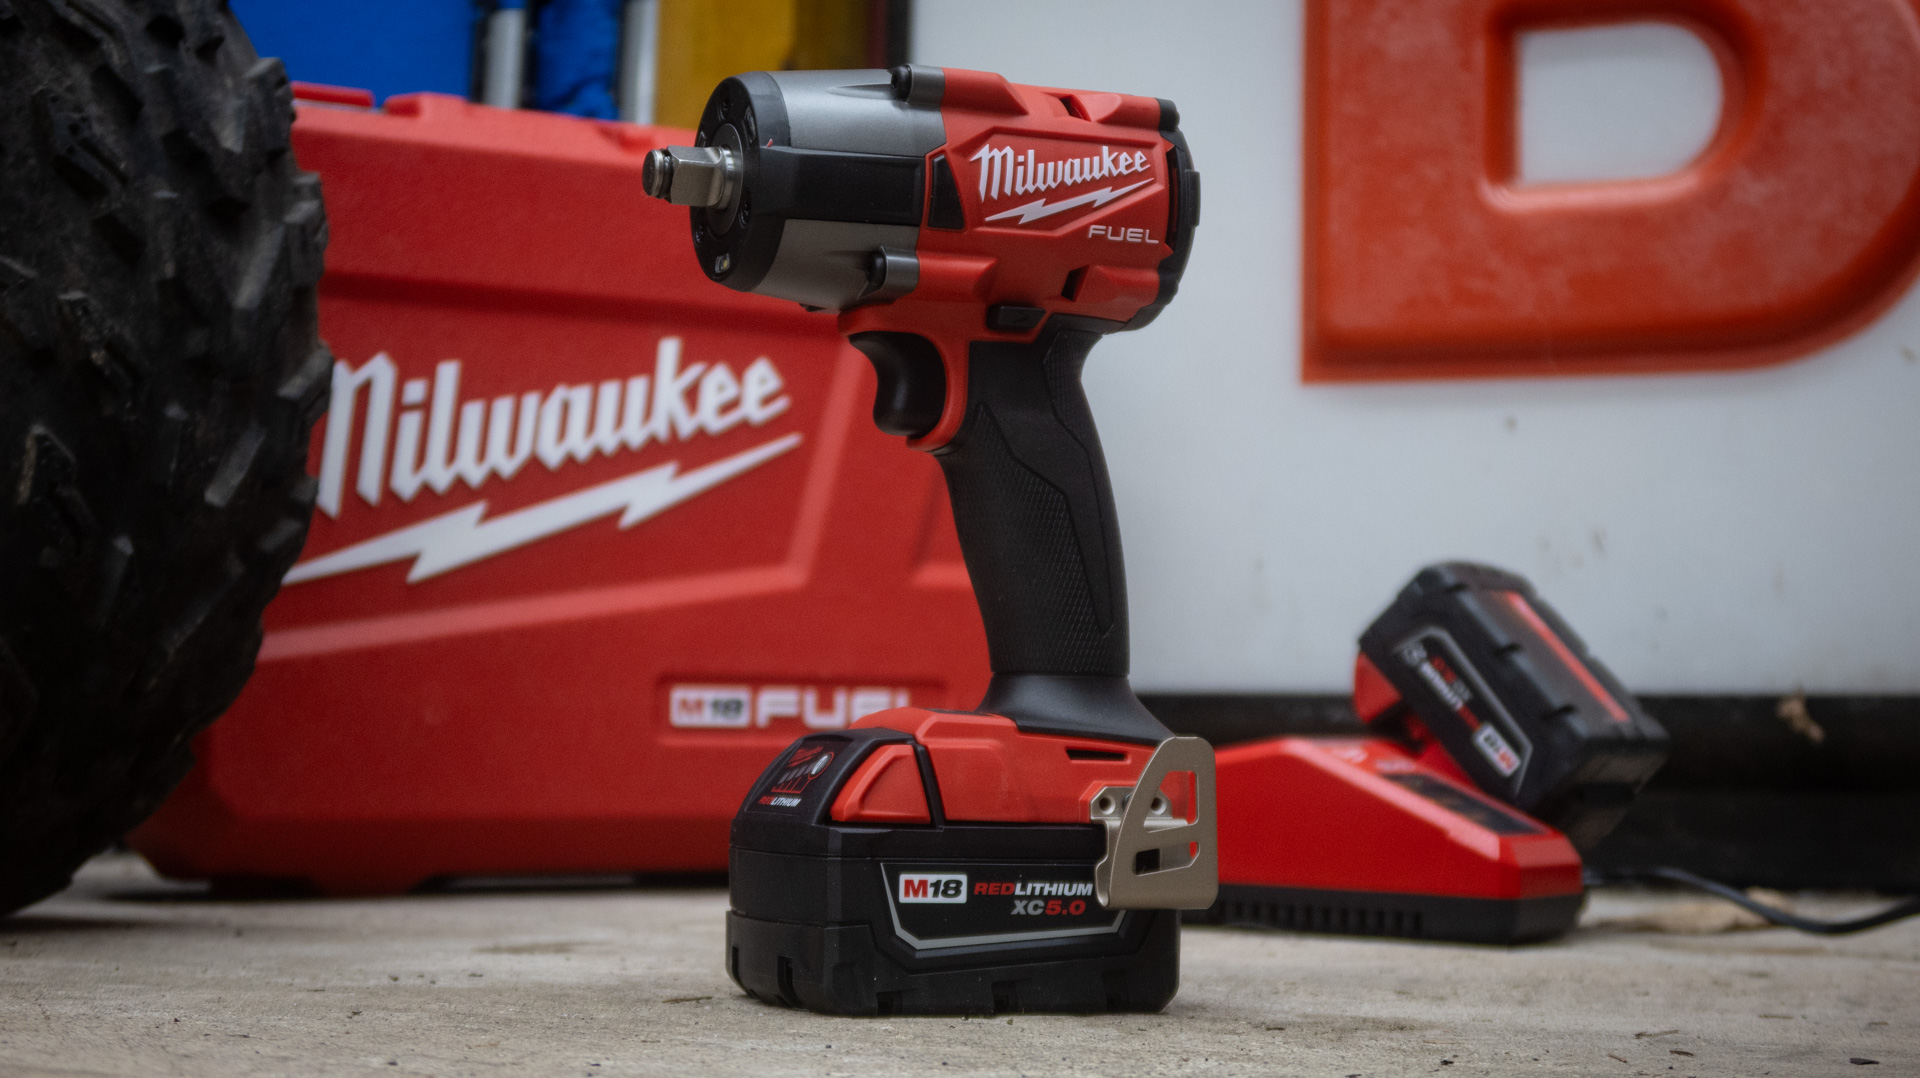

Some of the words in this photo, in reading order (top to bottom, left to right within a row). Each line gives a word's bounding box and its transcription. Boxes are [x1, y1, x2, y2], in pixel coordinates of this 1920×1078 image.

[970, 144, 1151, 203] Milwaukee
[1088, 224, 1160, 244] FUEL
[316, 337, 793, 520] Milwaukee
[903, 879, 963, 899] M18
[974, 882, 1094, 896] REDLITHIUM
[1010, 900, 1087, 916] XC5.0
